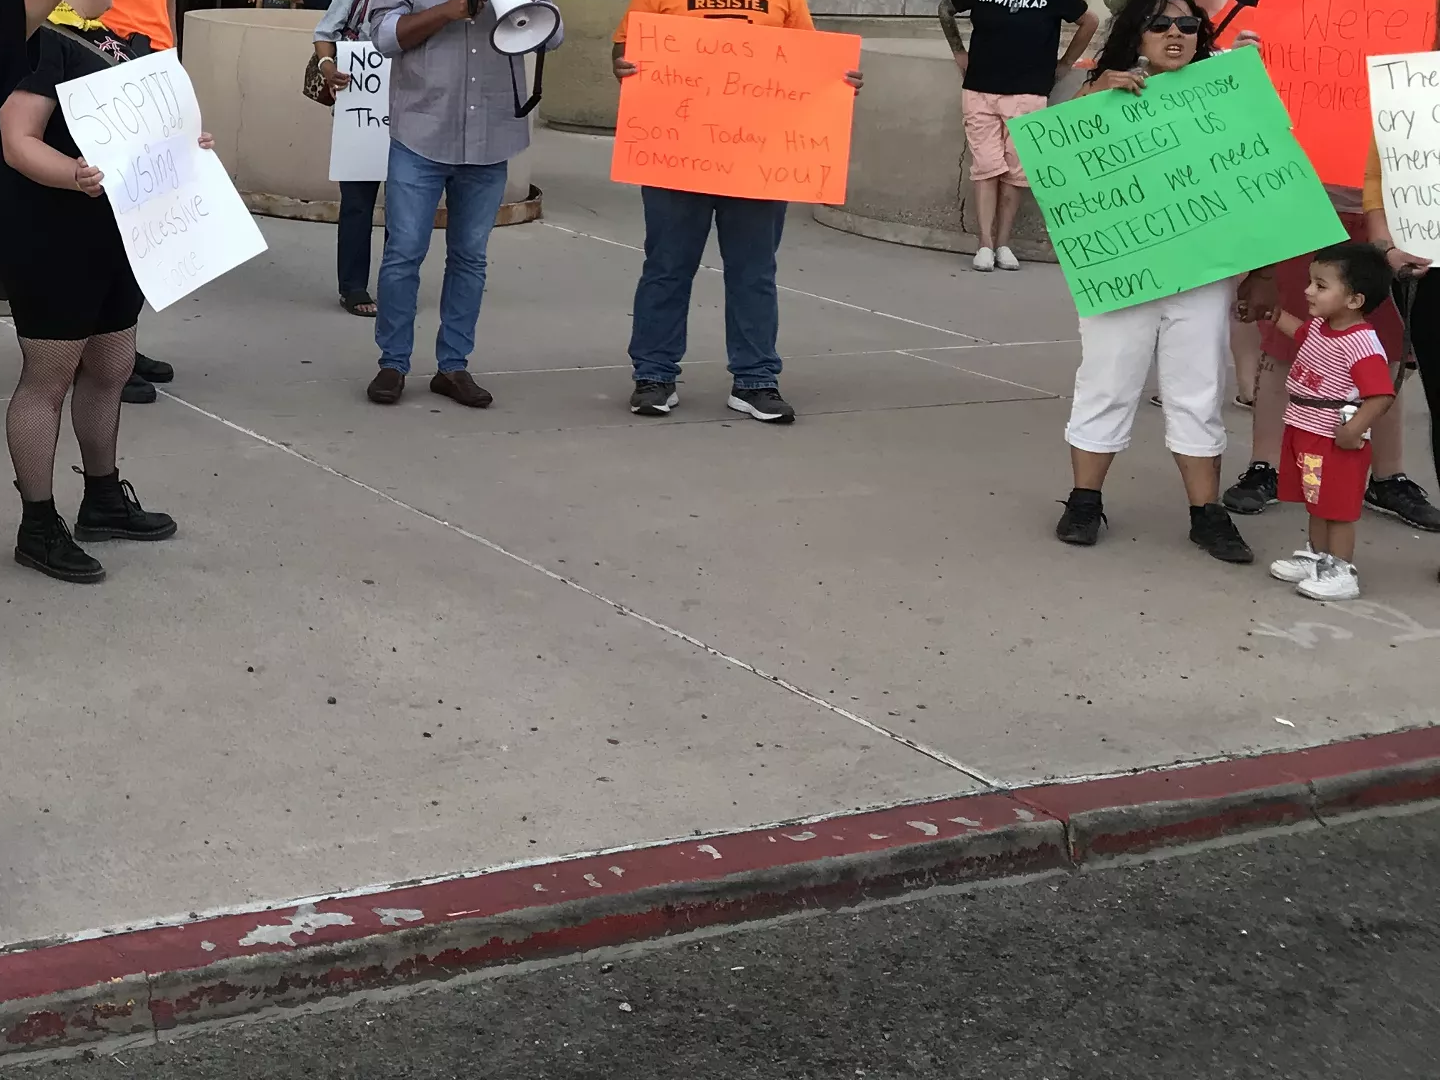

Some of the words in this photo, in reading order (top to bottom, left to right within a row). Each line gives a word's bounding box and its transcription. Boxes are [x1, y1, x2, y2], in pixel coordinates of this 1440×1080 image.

[349, 47, 384, 72] NO
[639, 23, 680, 53] He
[696, 37, 754, 58] was
[775, 45, 788, 64] A
[349, 72, 382, 94] NO
[637, 60, 710, 97] Father,
[722, 71, 812, 101] Brother
[345, 107, 390, 128] The
[626, 116, 680, 141] Son
[702, 123, 768, 153] Today
[1020, 113, 1111, 154] Police
[1120, 97, 1157, 124] are
[1160, 74, 1239, 114] suppose
[1377, 109, 1416, 140] cry
[1035, 164, 1067, 190] to
[1074, 120, 1181, 177] PROTECT
[1048, 174, 1146, 229] instead
[1164, 164, 1200, 194] we
[1209, 132, 1271, 175] need
[131, 195, 210, 259] excessive
[1056, 189, 1229, 270] PROTECTION
[1236, 159, 1308, 205] from
[1076, 267, 1162, 309] them
